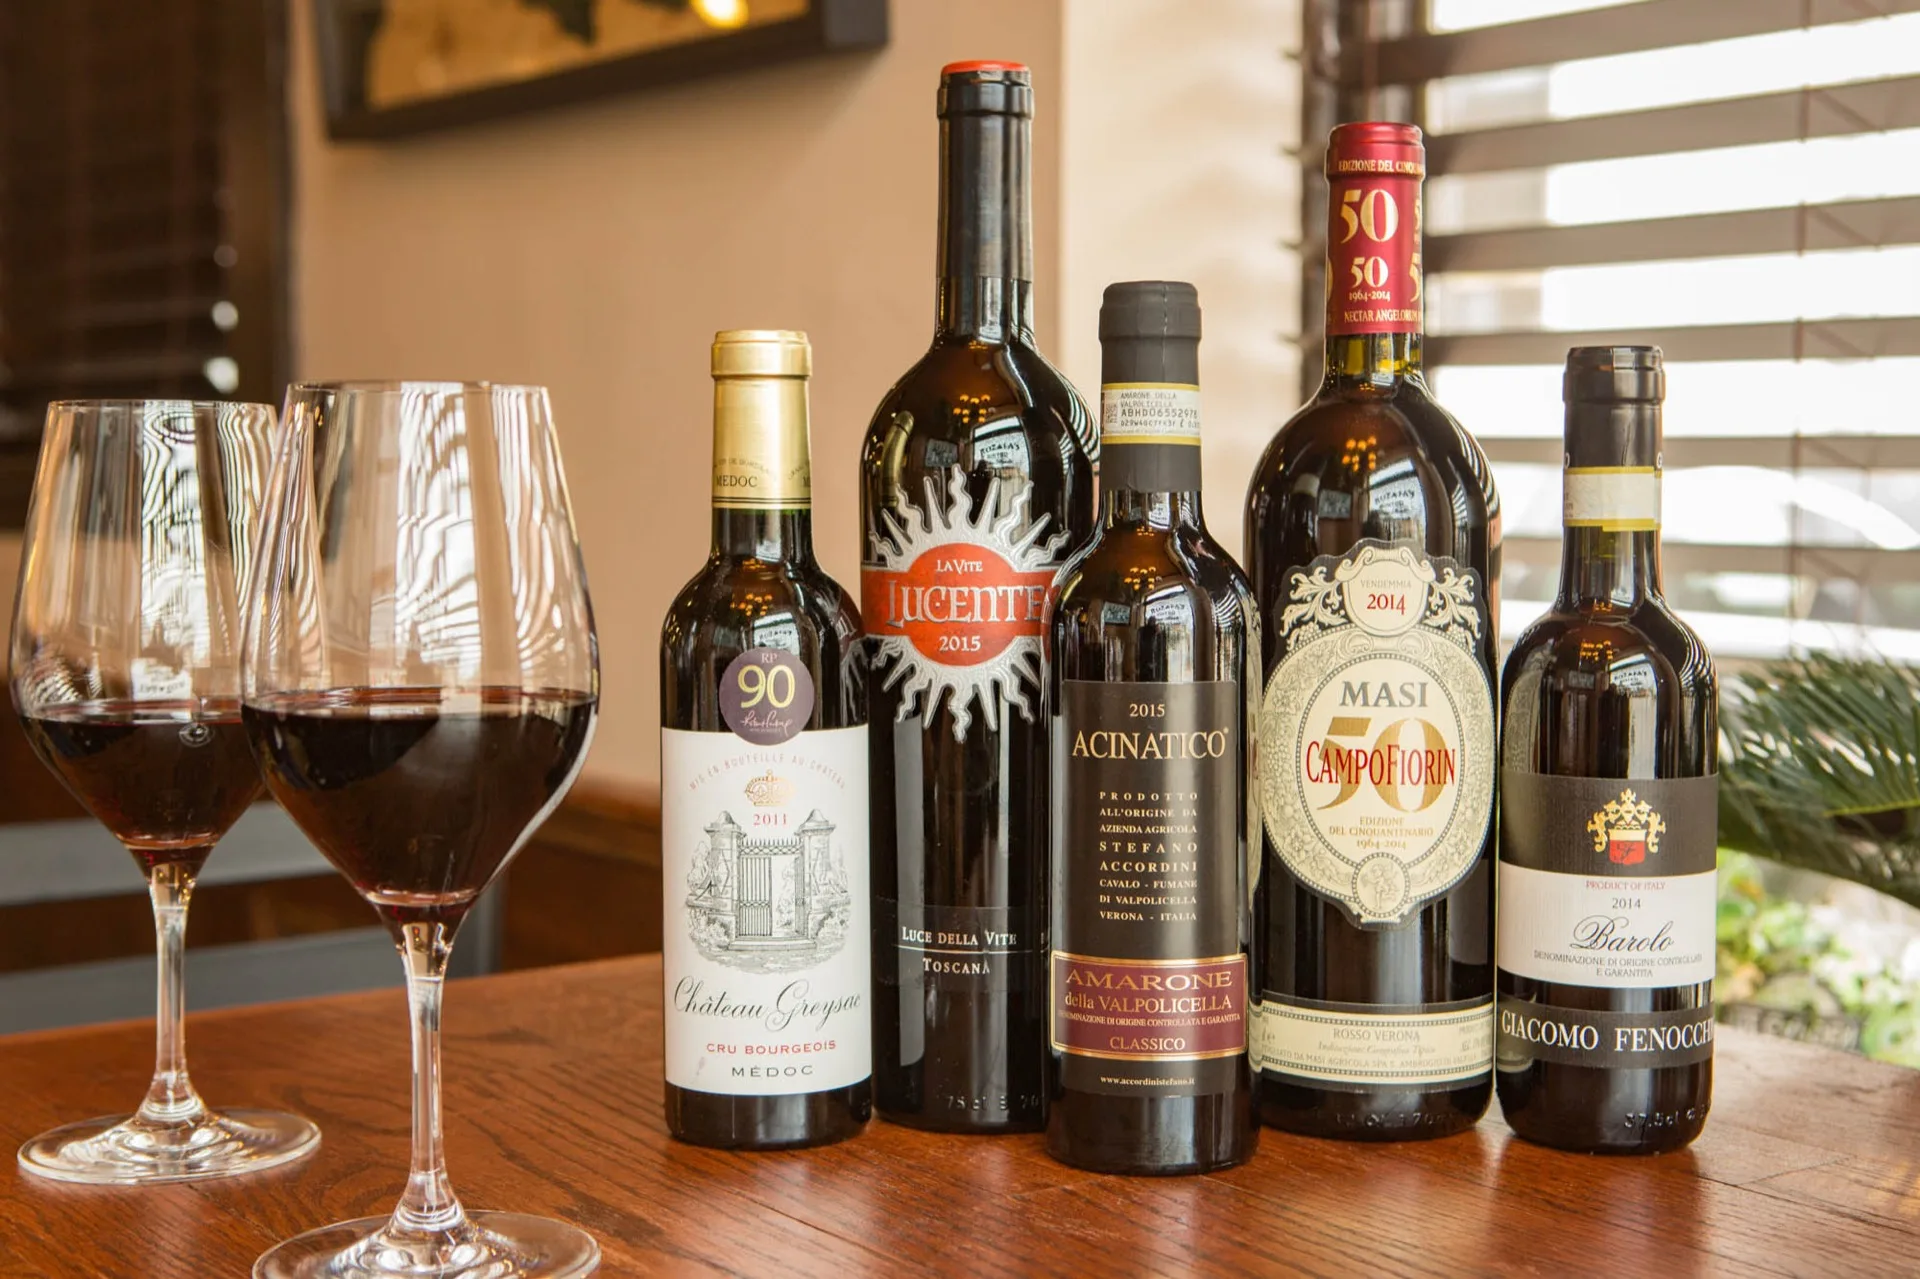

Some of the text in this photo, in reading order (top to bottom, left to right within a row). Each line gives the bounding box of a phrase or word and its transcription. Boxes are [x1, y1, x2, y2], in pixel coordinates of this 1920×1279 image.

[1339, 160, 1376, 172] EDIZIONE
[1377, 160, 1395, 172] DEL
[1340, 188, 1399, 244] 50
[1350, 256, 1389, 288] 50
[1344, 309, 1374, 323] NECTAR
[1360, 579, 1411, 589] VENDEMMIA
[887, 580, 1045, 628] LUCENTE
[1366, 593, 1406, 616] 2014
[939, 636, 981, 652] 2015
[761, 652, 778, 664] RP
[737, 664, 796, 709] 90
[1338, 681, 1429, 708] MASI
[1129, 703, 1165, 718] 2015
[1100, 792, 1198, 801] PRODOTTO
[753, 813, 787, 826] 2011
[1100, 808, 1198, 817] ALL'ORIGINE DA
[1360, 816, 1404, 826] EDIZIONE
[1100, 825, 1198, 834] AZIENDA AGRICOLA
[1329, 825, 1434, 837] DEL CINQUANTENARIO
[1100, 841, 1198, 853] STEFANO
[1100, 861, 1198, 873] ACCORDINI
[1100, 879, 1198, 889] CAVALO FUMANE
[1586, 880, 1666, 890] PRODUCT OF ITALY
[1100, 895, 1197, 905] DI VALPOLICELLA
[1612, 897, 1641, 909] 2014
[1100, 911, 1197, 921] VERONA ITALIA
[902, 926, 1017, 946] LUCE DELLA VITE
[1569, 914, 1675, 952] Barolo
[923, 957, 991, 974] TOSCANA
[1534, 950, 1604, 966] DENOMINAZIONE
[1608, 957, 1617, 966] DI
[1619, 957, 1655, 967] ORIGINE
[1605, 968, 1653, 977] GARANTITA
[1066, 969, 1232, 991] AMARONE
[765, 978, 861, 1032] Greysac
[1065, 992, 1232, 1013] della VALPOLICELLA
[1107, 1017, 1115, 1026] DI
[1116, 1018, 1146, 1027] ORIGINE
[1147, 1018, 1200, 1027] CONTROLLATA
[1207, 1013, 1240, 1024] GARANTITA
[1333, 1028, 1421, 1042] ROSSO VERONA
[1501, 1009, 1599, 1050] GIACOMO
[707, 1040, 836, 1055] CRU BOURGEOIS
[1110, 1036, 1186, 1050] CLASSICO
[731, 1065, 813, 1077] MÉDOC
